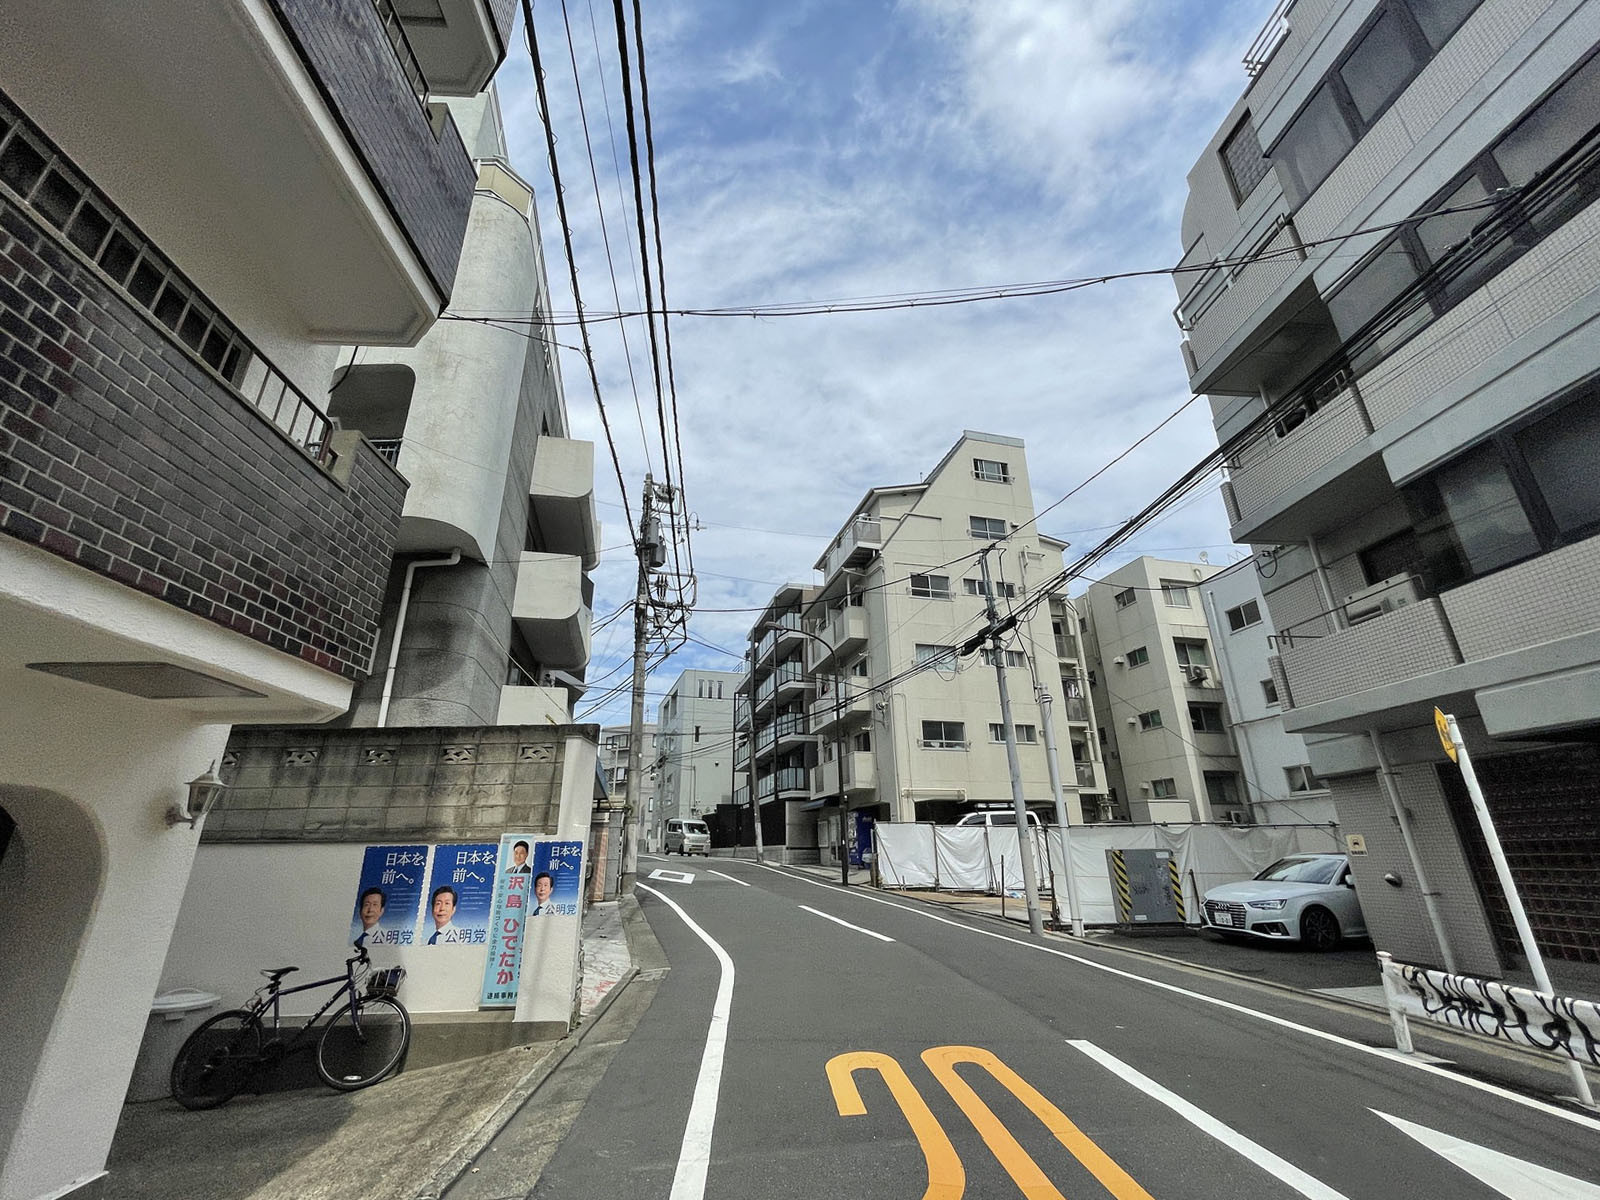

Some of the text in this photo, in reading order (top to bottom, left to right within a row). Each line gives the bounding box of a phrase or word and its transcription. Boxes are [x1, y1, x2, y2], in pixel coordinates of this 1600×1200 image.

[385, 852, 426, 867] 日本を、
[455, 851, 498, 866] 日本を、
[549, 859, 575, 871] 前へ。
[381, 869, 415, 885] 前へ。
[452, 868, 486, 884] 前へ。
[544, 903, 577, 916] 公明党
[371, 929, 415, 945] 公明党
[444, 928, 487, 944] 公明党
